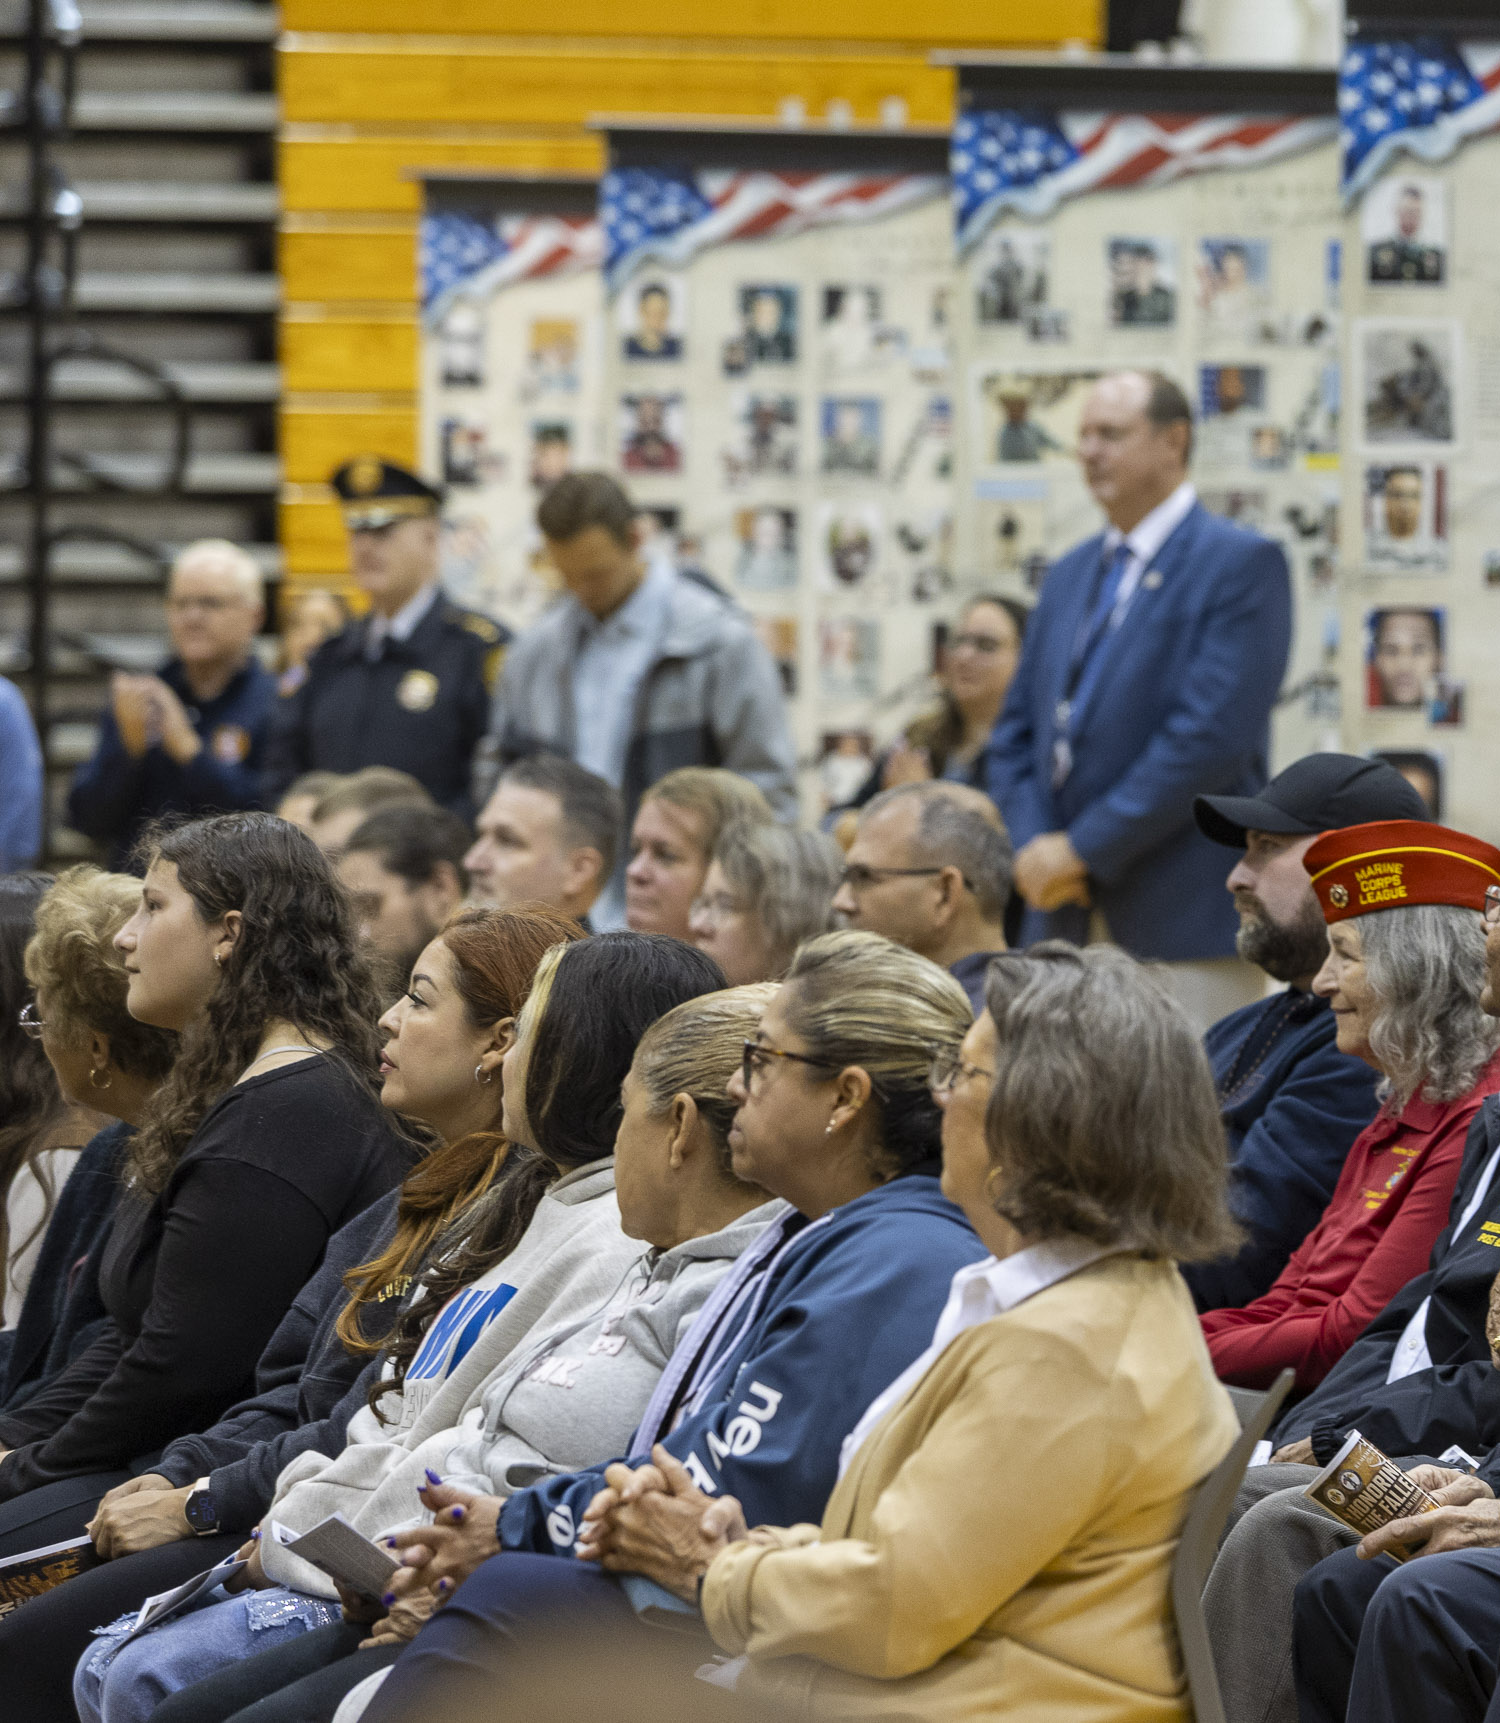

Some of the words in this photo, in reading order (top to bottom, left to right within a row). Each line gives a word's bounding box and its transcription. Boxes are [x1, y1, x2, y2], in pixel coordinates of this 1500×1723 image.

[1355, 862, 1404, 880] MARINE
[1360, 874, 1402, 893] CORPS
[1359, 885, 1408, 905] LEAGUE
[1362, 1509, 1387, 1531] THE
